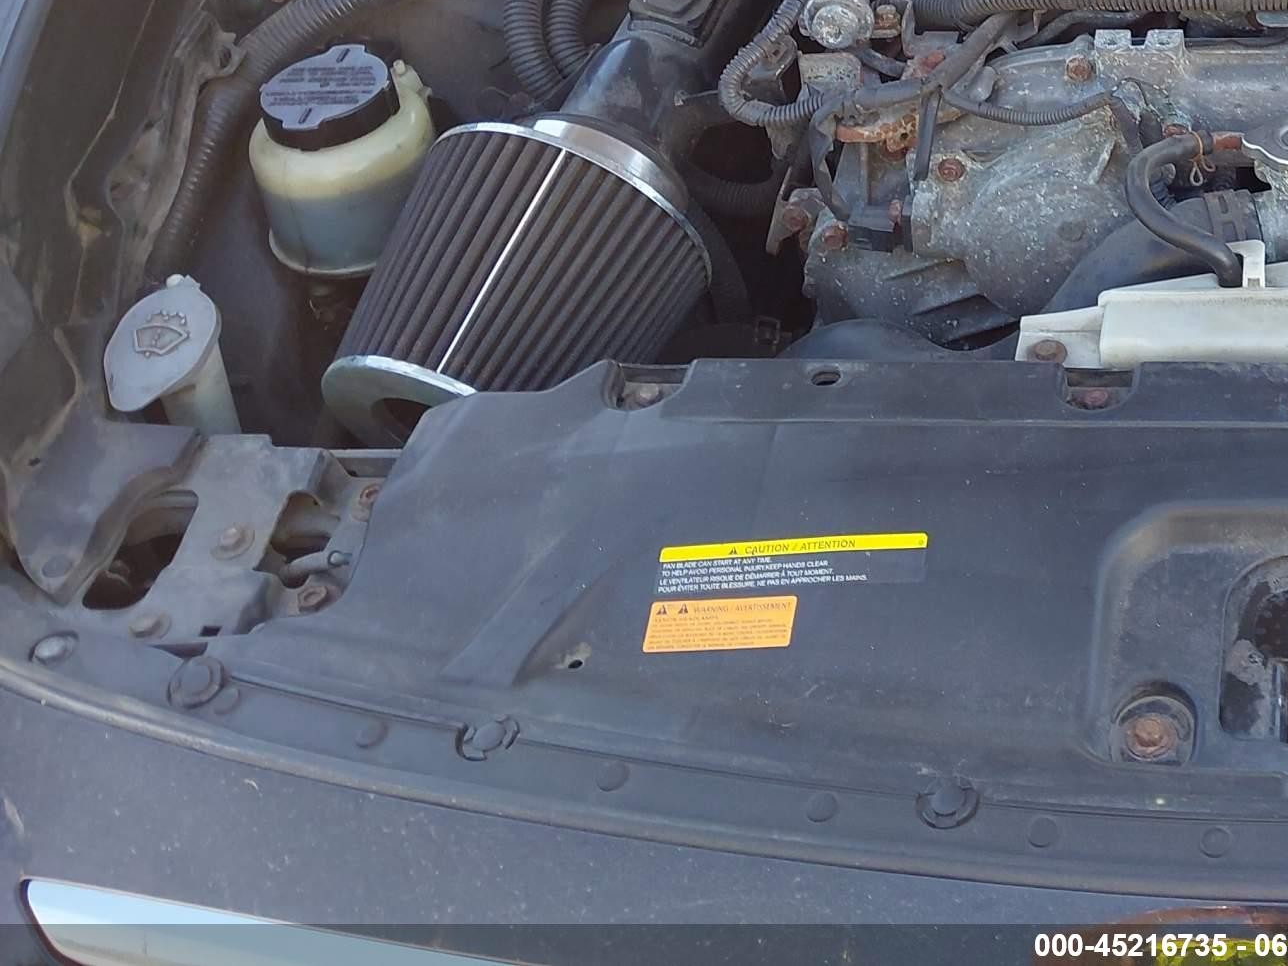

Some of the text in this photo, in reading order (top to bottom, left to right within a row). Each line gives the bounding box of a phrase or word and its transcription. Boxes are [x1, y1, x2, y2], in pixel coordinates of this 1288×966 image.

[744, 543, 789, 554] CAUTION
[800, 539, 855, 550] ATTENTION
[709, 566, 742, 574] PERSONAL
[668, 575, 709, 584] VENTILATEUR
[710, 574, 733, 582] RISQUE
[790, 575, 831, 584] APPROCHER
